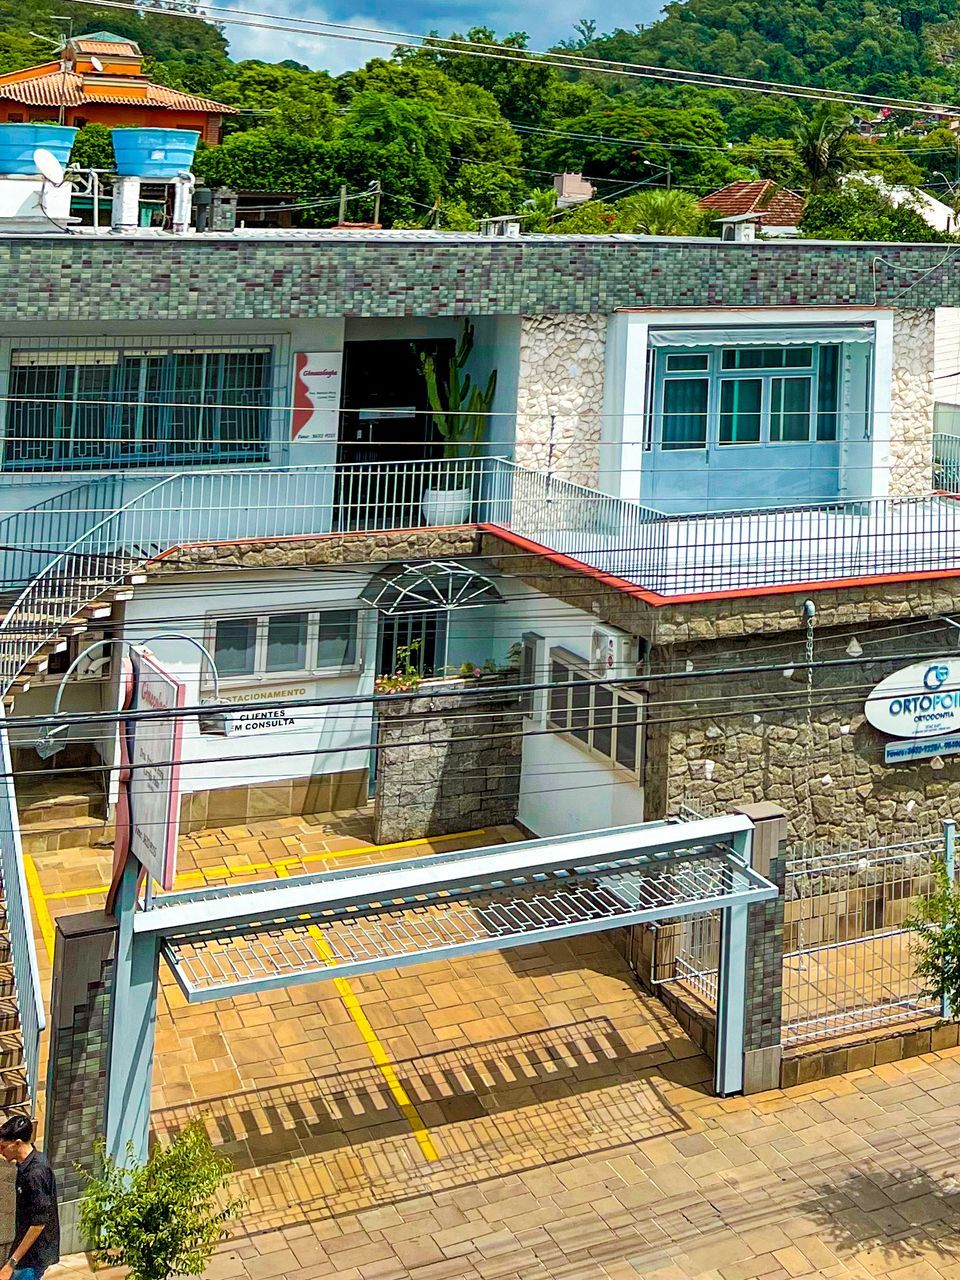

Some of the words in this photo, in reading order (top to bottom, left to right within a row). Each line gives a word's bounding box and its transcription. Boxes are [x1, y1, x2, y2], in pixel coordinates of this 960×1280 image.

[239, 710, 286, 722] CLIENTES
[913, 711, 955, 723] ORTODONTIA
[245, 718, 295, 731] CONSULTA
